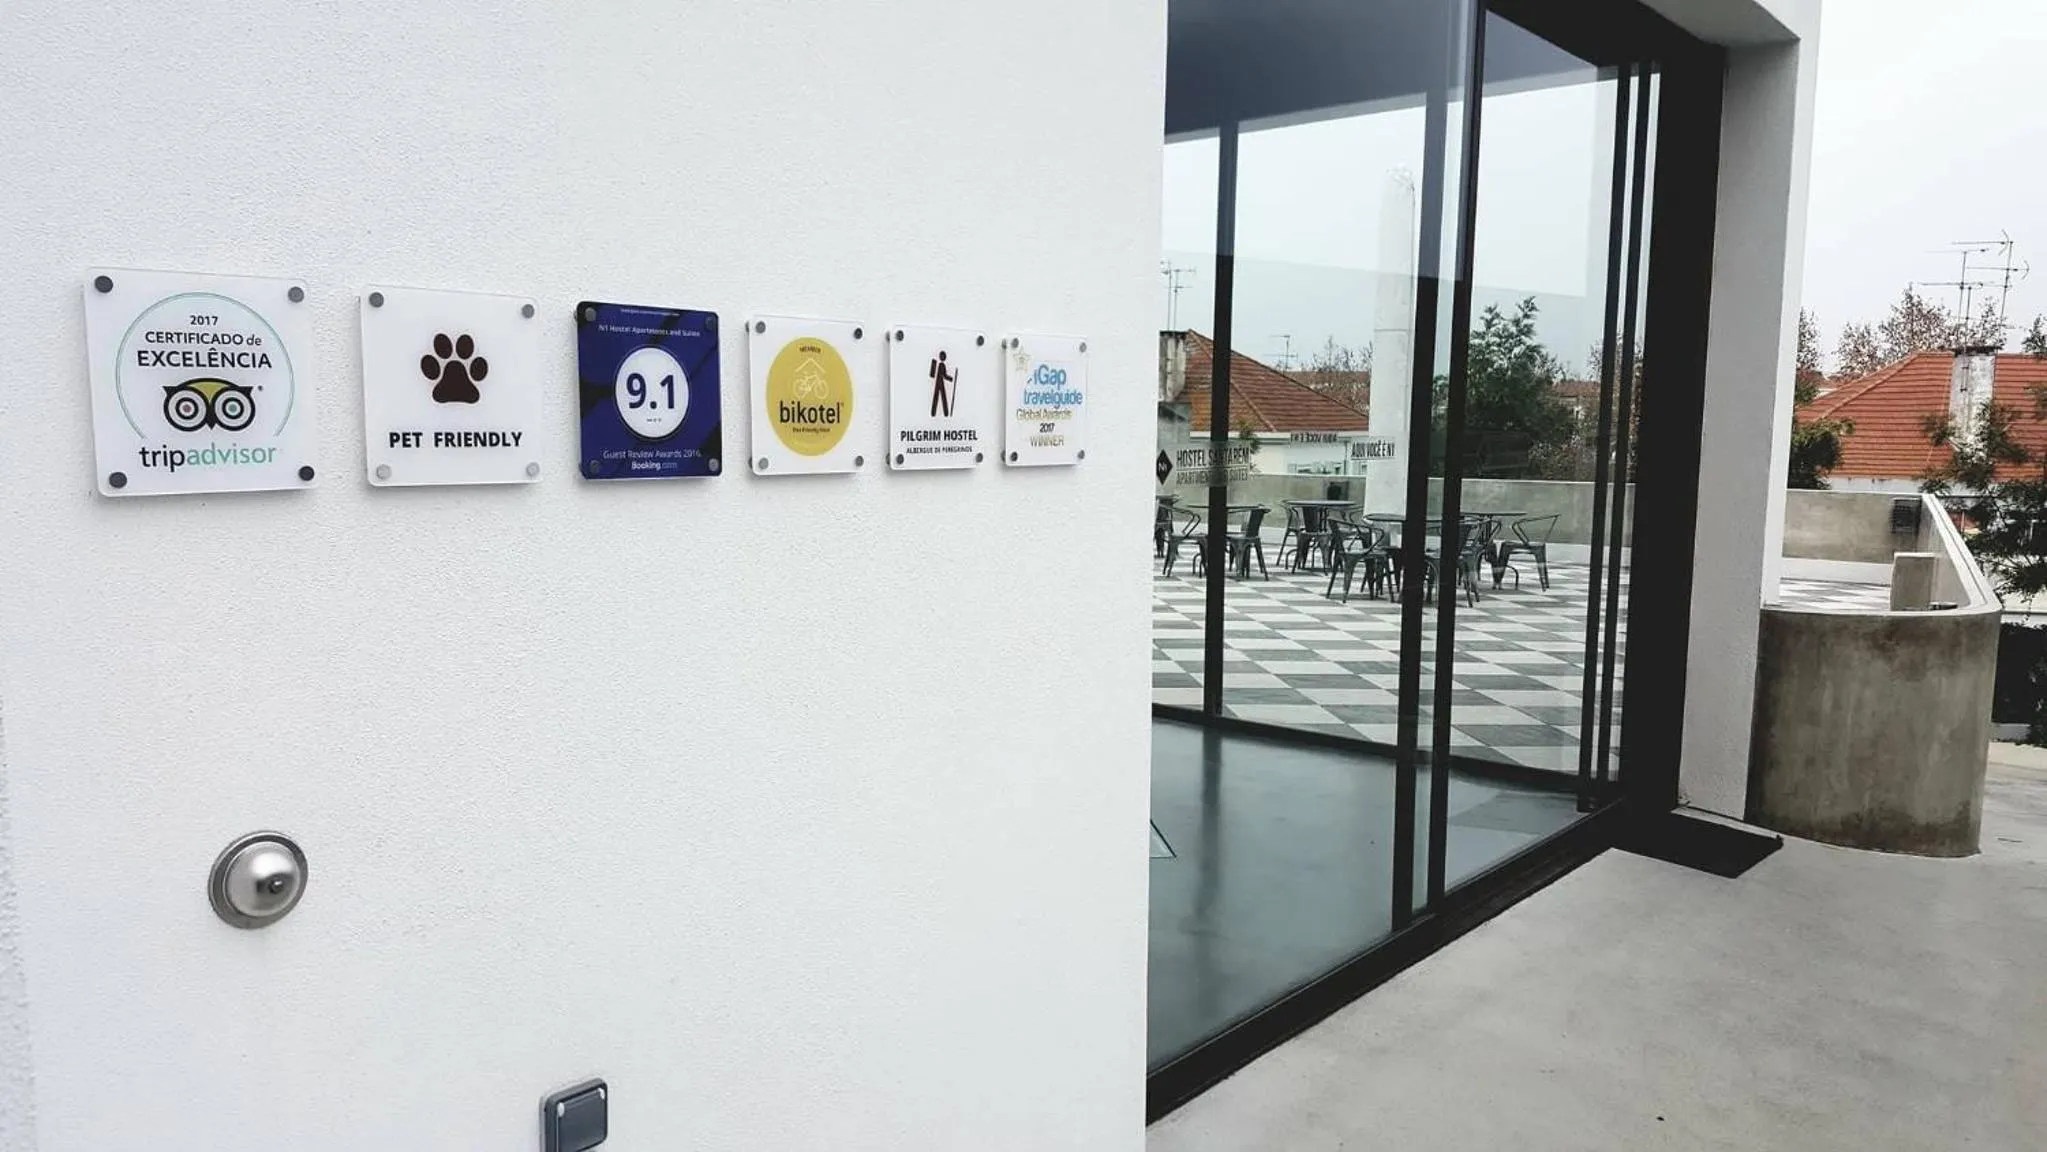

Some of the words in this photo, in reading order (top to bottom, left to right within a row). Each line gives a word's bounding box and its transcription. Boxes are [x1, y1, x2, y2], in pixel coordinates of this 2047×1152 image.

[190, 315, 218, 326] 2017
[145, 331, 244, 345] CERTIFICADO
[246, 334, 262, 346] de
[137, 348, 272, 369] EXCELÊNCIA
[626, 373, 675, 410] 9.1
[1024, 388, 1083, 409] travelguide
[779, 400, 840, 424] bikotel
[900, 430, 941, 442] PILGRIM
[943, 430, 978, 441] HOSTEL
[1039, 423, 1055, 433] 2017
[389, 432, 423, 448] PET
[434, 431, 522, 448] FRIENDLY
[1030, 436, 1065, 447] WINNER
[139, 442, 277, 472] tripadvisor
[603, 451, 626, 460] Guest
[627, 450, 653, 459] Review
[655, 450, 682, 459] Awards
[1177, 449, 1206, 467] HOSTEL
[632, 461, 678, 471] Booking.com
